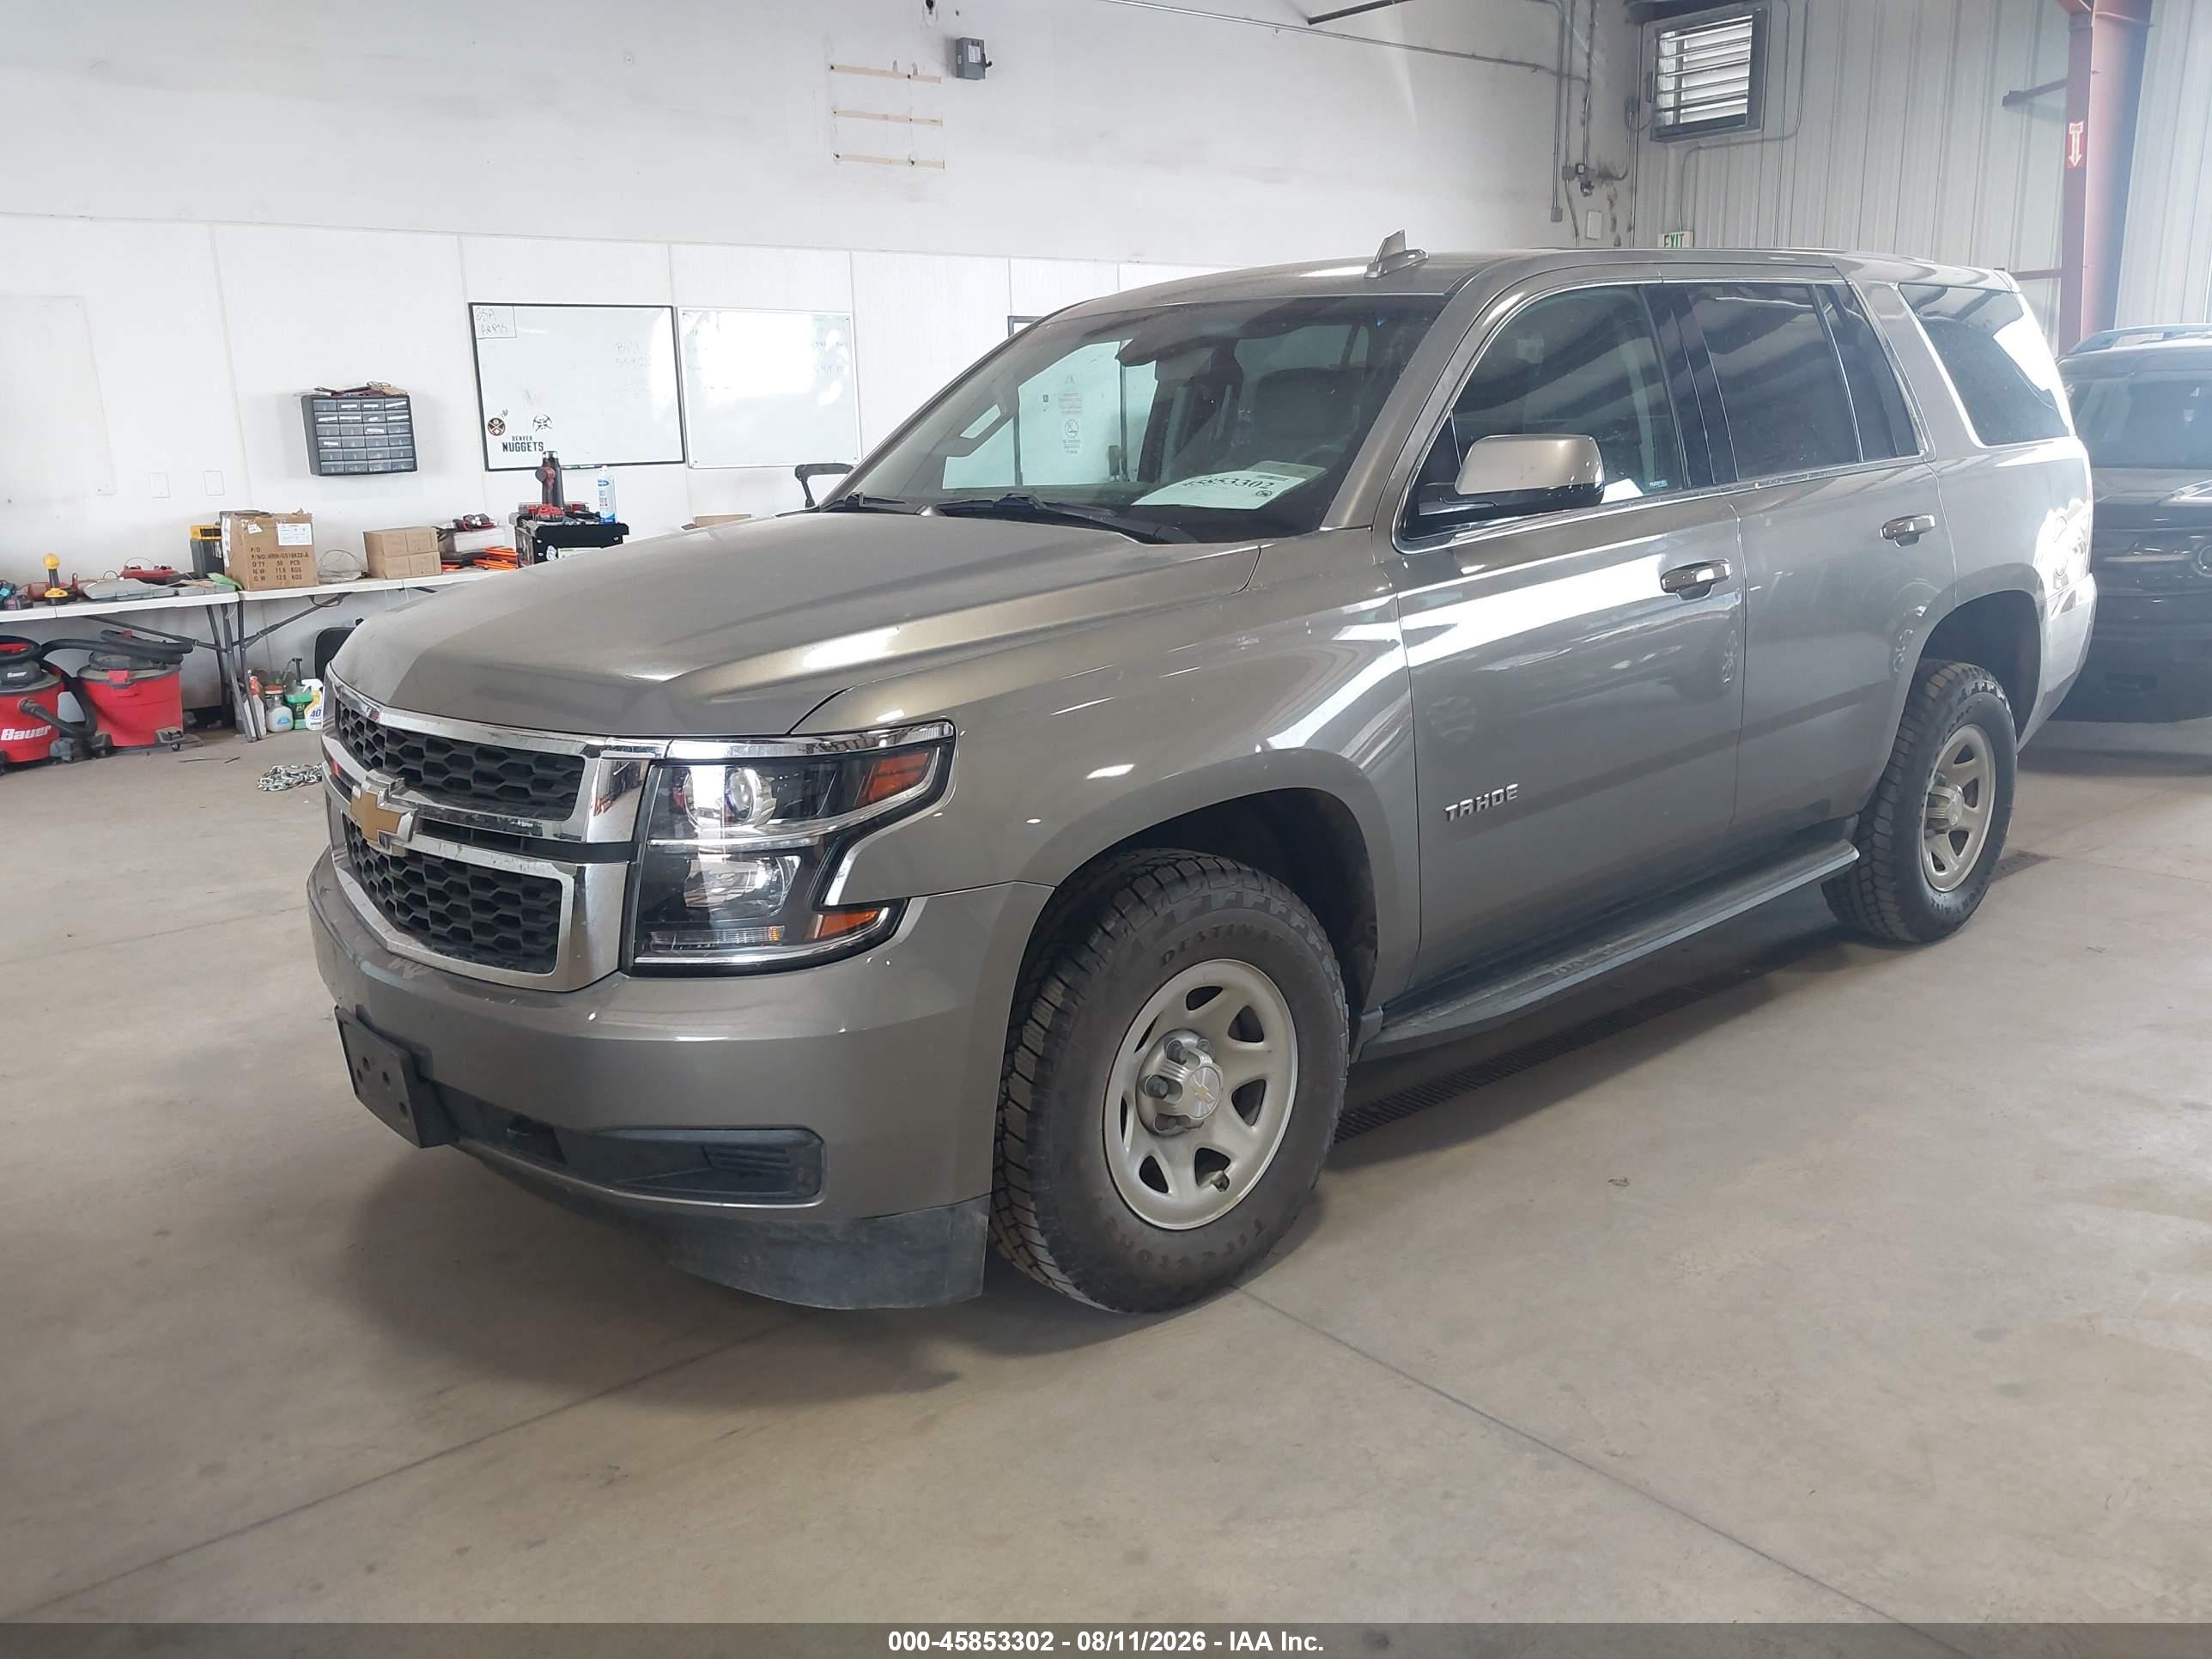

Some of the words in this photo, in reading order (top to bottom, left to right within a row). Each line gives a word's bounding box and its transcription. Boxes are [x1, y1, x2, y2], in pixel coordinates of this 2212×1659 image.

[501, 441, 544, 453] NUGGETS
[1, 725, 52, 741] Bauer
[1445, 783, 1518, 822] TAHOE
